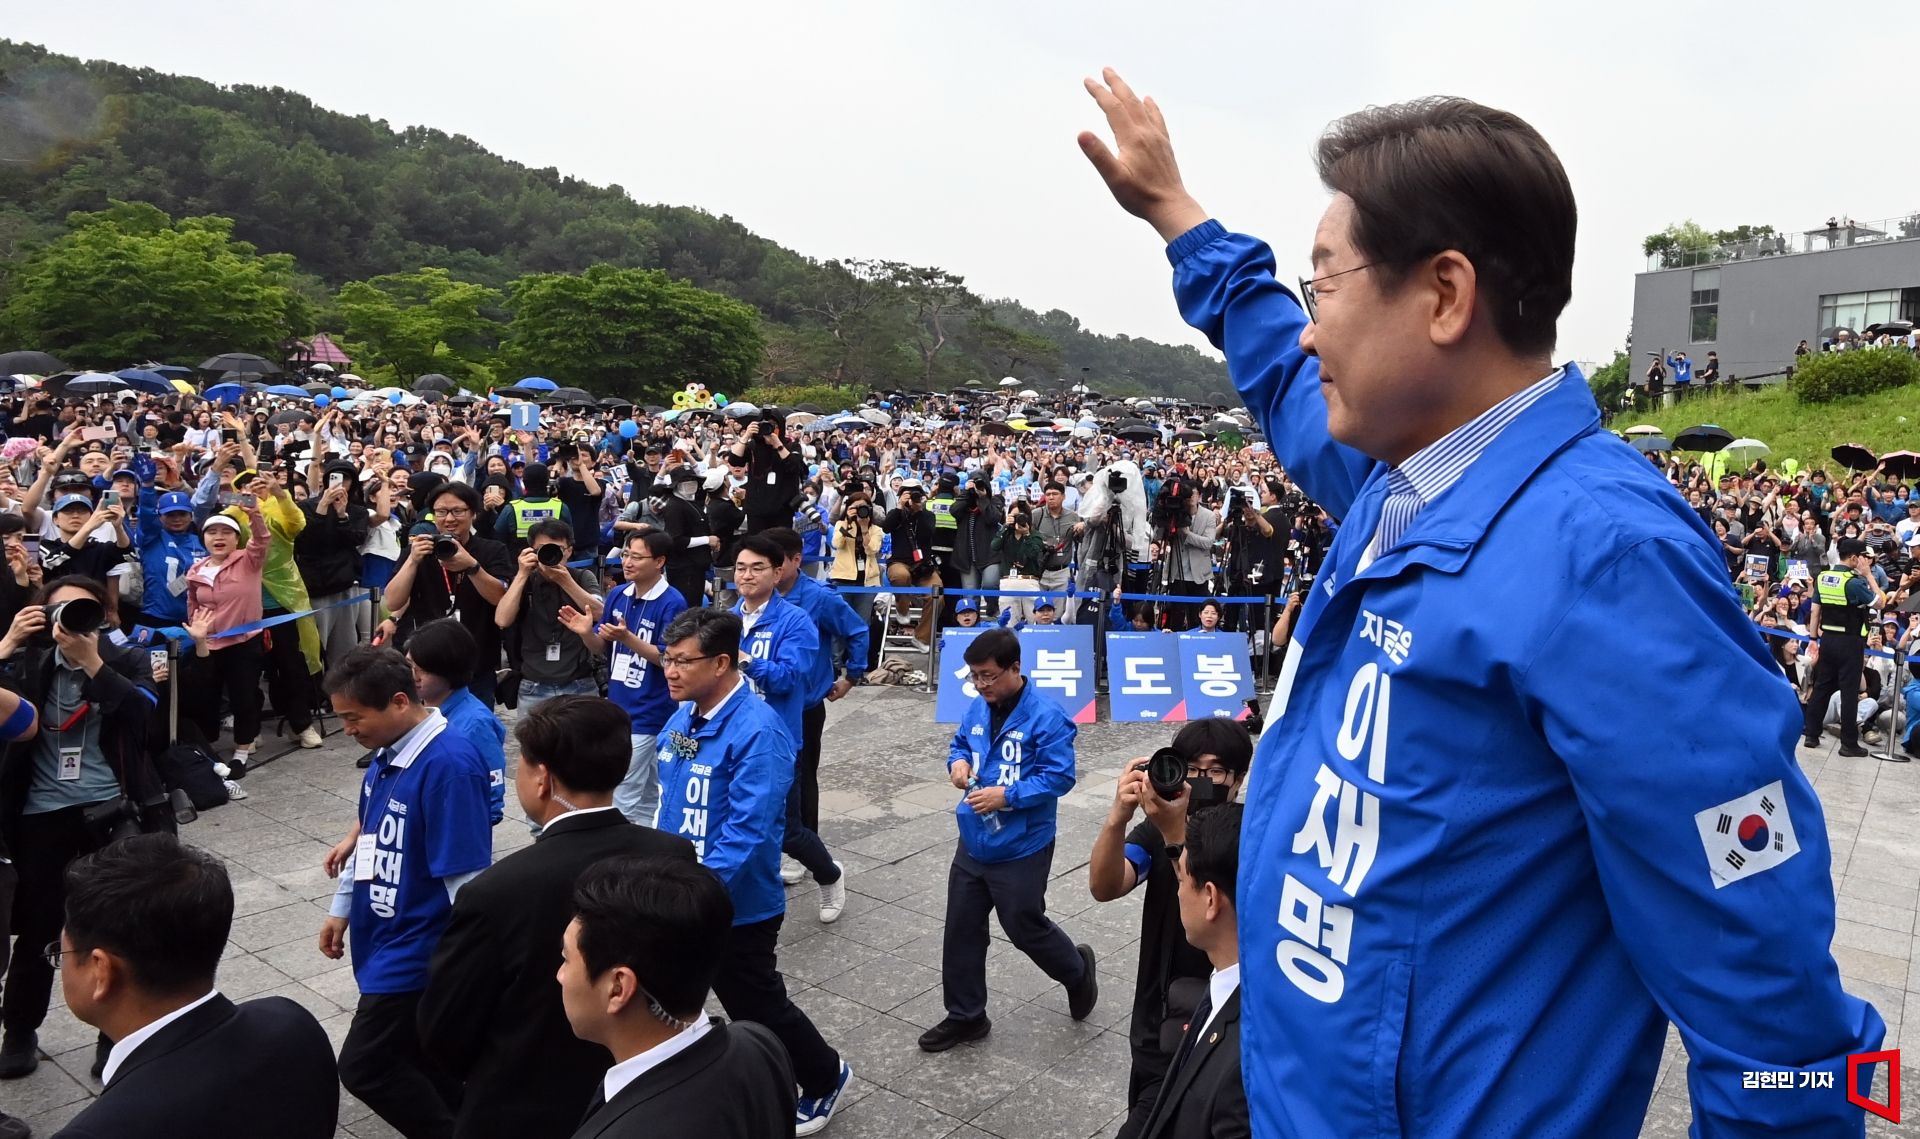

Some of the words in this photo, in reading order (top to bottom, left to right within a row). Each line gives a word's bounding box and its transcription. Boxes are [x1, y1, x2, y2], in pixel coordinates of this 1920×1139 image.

[519, 405, 529, 427] 1
[171, 494, 178, 504] 1
[1359, 610, 1413, 666] 지금은
[1030, 649, 1083, 697] 북
[690, 763, 712, 776] 지금은
[996, 740, 1022, 787] 이재
[1276, 662, 1392, 1004] 이재명
[369, 813, 405, 918] 이재명
